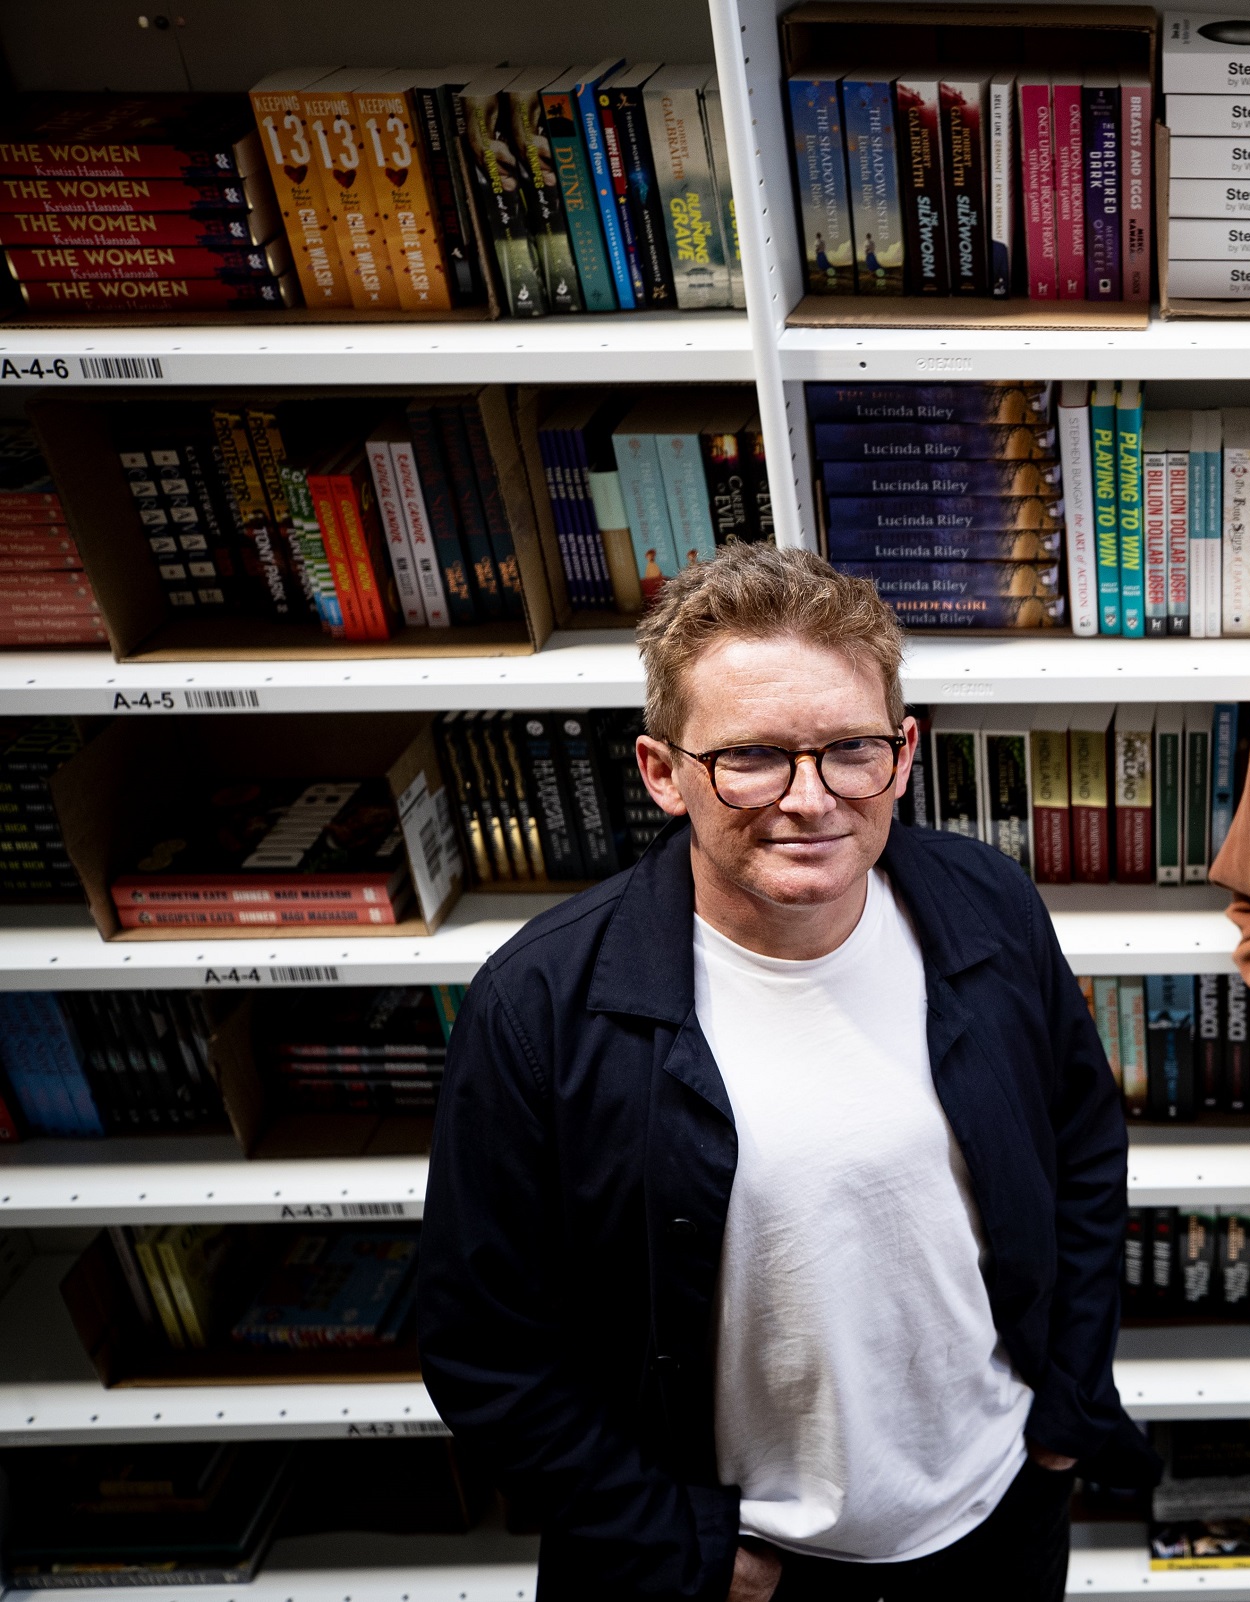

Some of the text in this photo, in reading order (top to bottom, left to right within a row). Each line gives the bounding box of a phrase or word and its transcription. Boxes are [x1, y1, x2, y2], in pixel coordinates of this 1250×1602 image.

[254, 95, 300, 112] KEEPING
[1228, 78, 1238, 88] by
[304, 100, 350, 117] KEEPING
[360, 99, 404, 115] KEEPING
[0, 145, 141, 163] THE WOMEN
[262, 116, 311, 165] 13
[312, 119, 360, 169] 13
[365, 118, 412, 168] 13
[585, 112, 603, 175] finding flow
[663, 98, 684, 181] GALBRAITH
[908, 107, 925, 188] GALBRAITH
[951, 106, 966, 188] GALBRAITH
[1130, 96, 1142, 210] BREASTS AND EGGS
[4, 181, 150, 199] THE WOMEN
[555, 147, 583, 211] DUNE
[817, 107, 839, 240] THE SHADOW SISTER
[1090, 151, 1103, 188] DARK
[1102, 132, 1117, 214] FRACTURED
[14, 215, 157, 232] THE WOMEN
[670, 198, 693, 260] GRAVE
[686, 193, 709, 264] RUNNING
[917, 195, 936, 278] SILKWORM
[956, 195, 975, 278] SILKWORM
[32, 249, 176, 267] THE WOMEN
[47, 281, 188, 299] THE WOMEN
[1, 358, 69, 380] A-4-6
[857, 405, 954, 420] Lucinda Riley
[864, 443, 961, 458] Lucinda Riley
[872, 480, 969, 495] Lucinda Riley
[1094, 428, 1118, 567] PLAYING TO WIN
[1119, 432, 1140, 570] PLAYING TO WIN
[1147, 470, 1164, 515] BILLION
[1170, 469, 1186, 514] BILLION
[715, 496, 734, 532] EVIL
[877, 515, 973, 530] Lucinda Riley
[1148, 519, 1164, 564] DOLLAR
[1170, 518, 1186, 563] DOLLAR
[1149, 569, 1165, 605] LOSER
[1170, 568, 1186, 604] LOSER
[113, 692, 175, 710] A-4-5
[1038, 737, 1051, 800] HOLLAND
[1078, 737, 1090, 800] HOLLAND
[1122, 737, 1136, 800] HOLLAND
[204, 967, 261, 984] A-4-4
[281, 1204, 333, 1218] A-4-3
[347, 1423, 395, 1437] A-4-2
